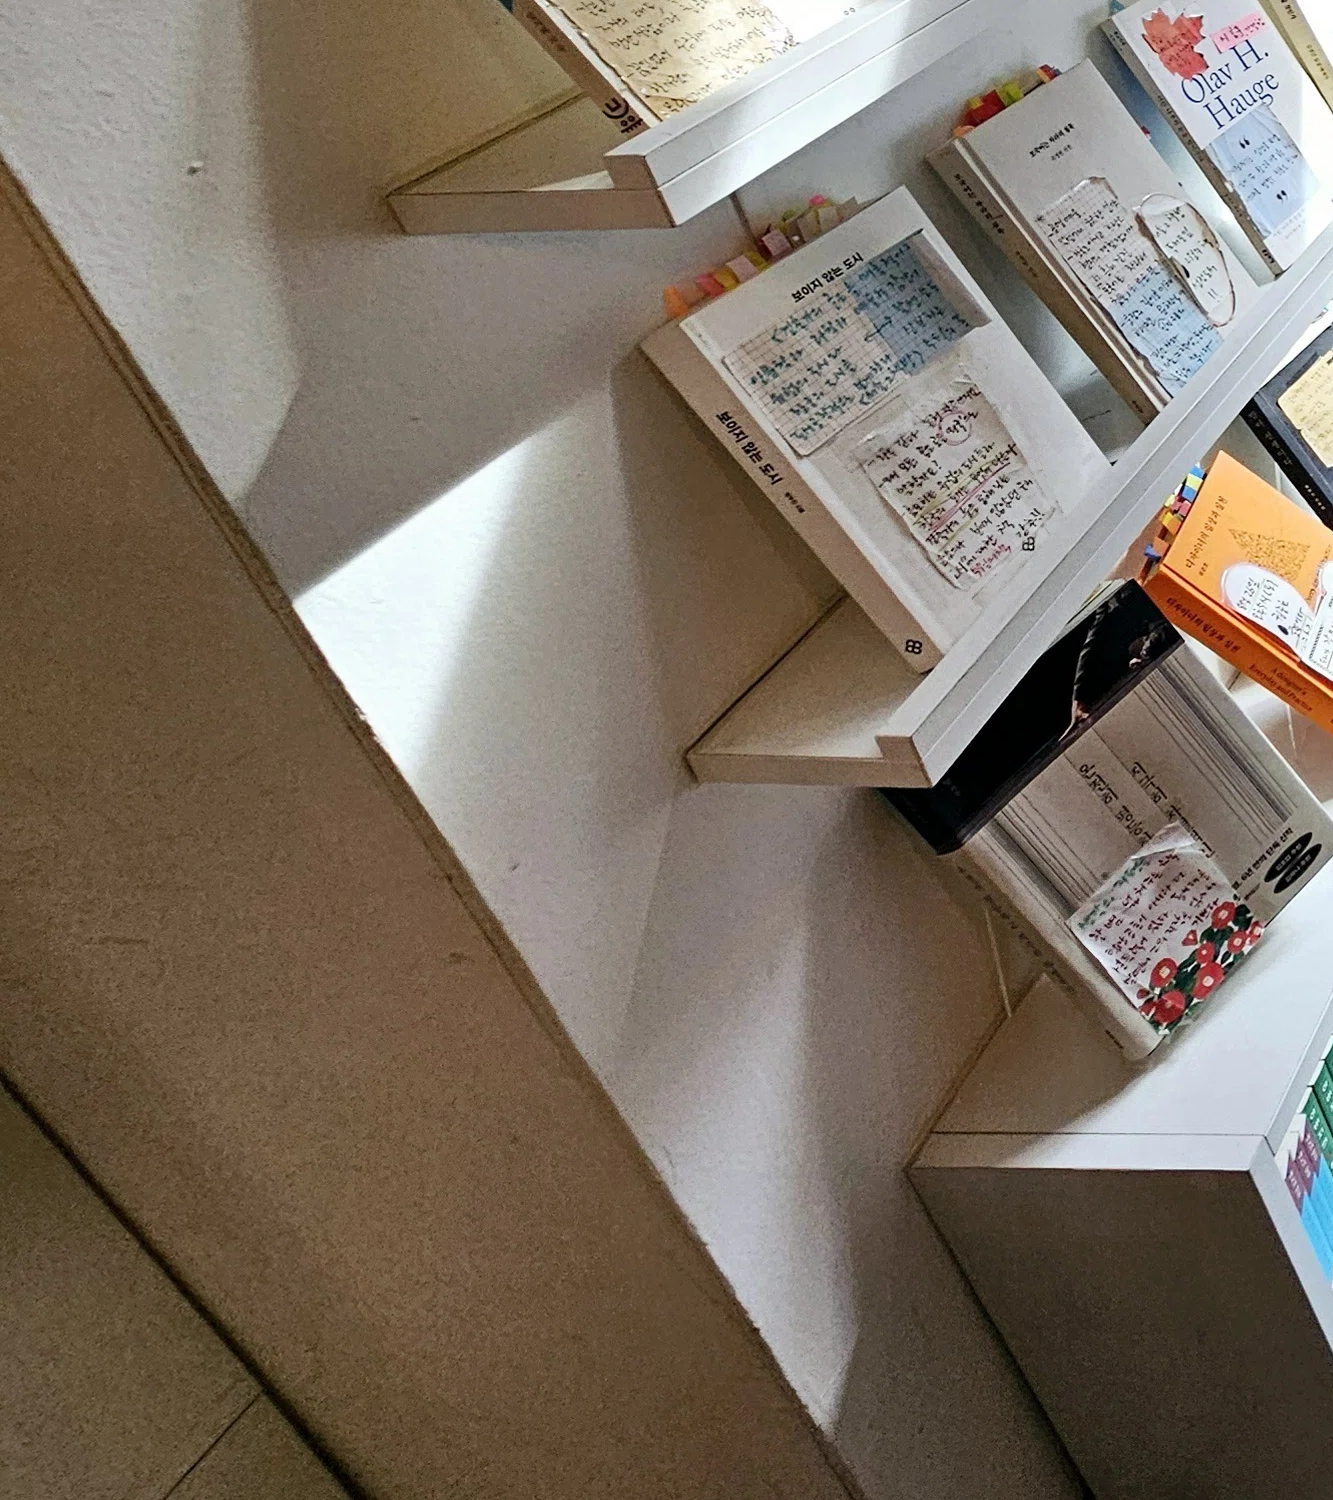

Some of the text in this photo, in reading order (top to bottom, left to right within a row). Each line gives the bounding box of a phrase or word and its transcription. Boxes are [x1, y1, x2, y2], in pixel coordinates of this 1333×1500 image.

[1181, 62, 1233, 104] Olav
[1230, 39, 1269, 73] H.
[1203, 73, 1279, 131] Hauge
[790, 251, 866, 304] 보이지 않는 도시
[715, 409, 782, 486] 보이지 않는 도시
[1184, 494, 1229, 569] 디자이너의 일상과 실천
[1249, 664, 1279, 689] Everyday
[1250, 857, 1268, 873] 만의
[1265, 841, 1282, 859] 단독
[1279, 826, 1296, 845] 신작
